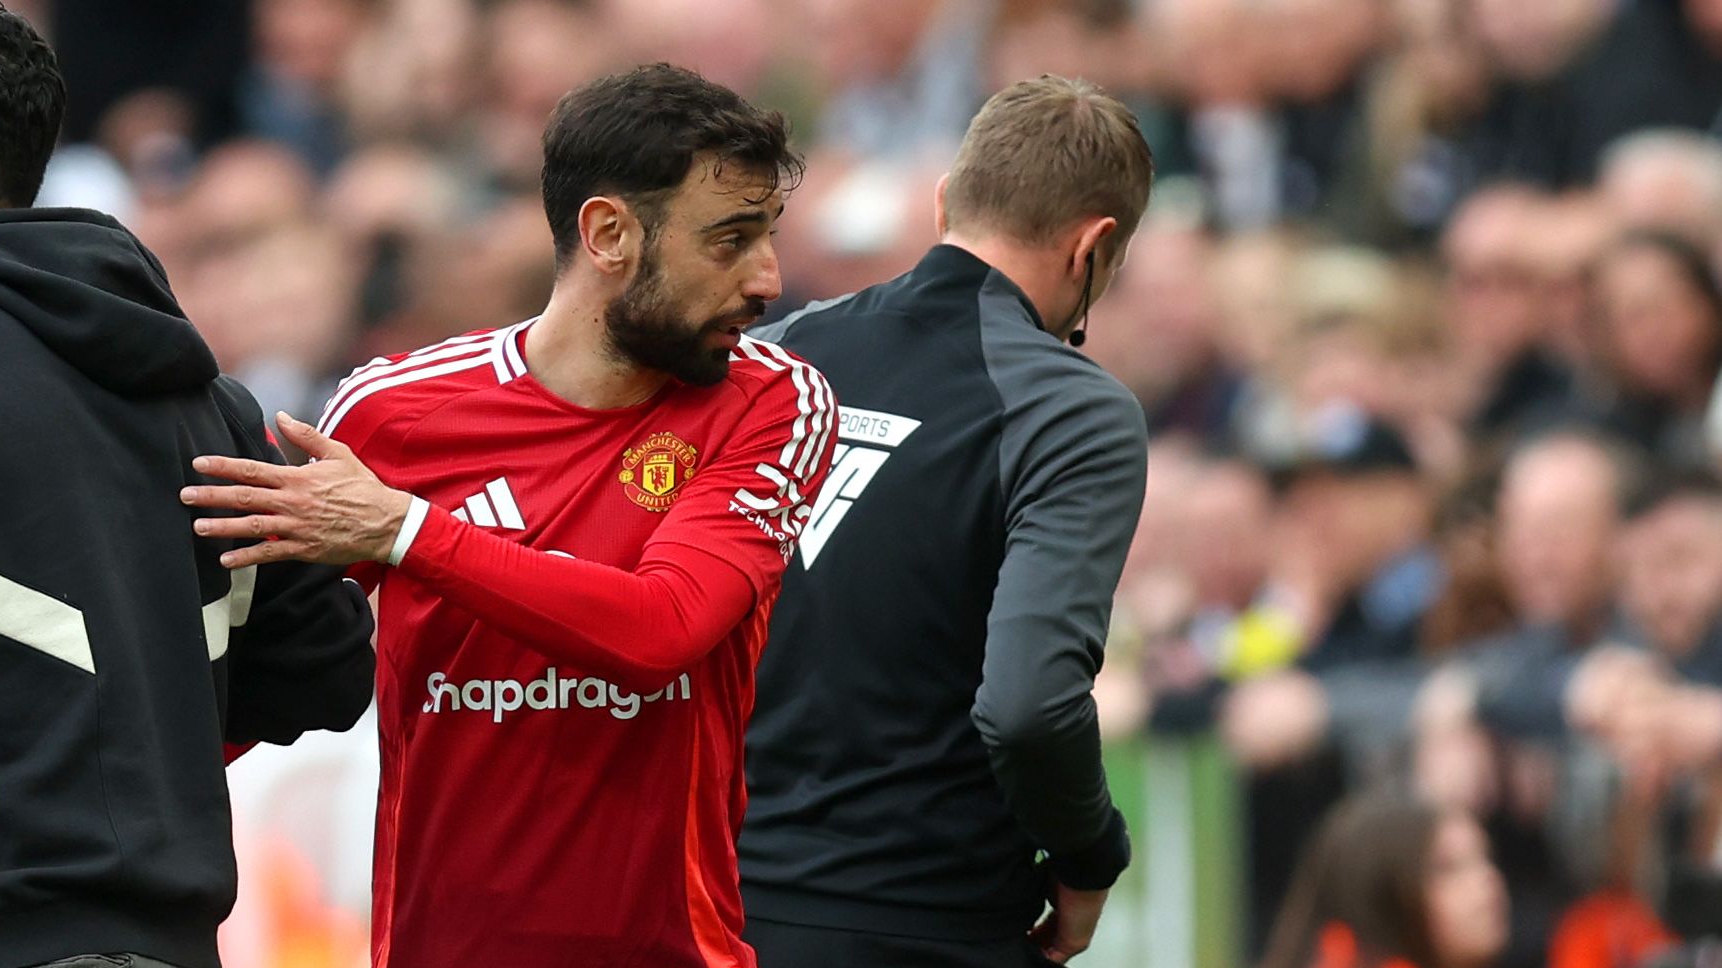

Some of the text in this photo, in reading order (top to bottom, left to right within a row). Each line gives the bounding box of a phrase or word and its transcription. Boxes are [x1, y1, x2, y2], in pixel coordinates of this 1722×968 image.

[839, 412, 891, 438] PORTS
[628, 437, 691, 465] MANCHESTER
[422, 666, 691, 723] Snapdragn
